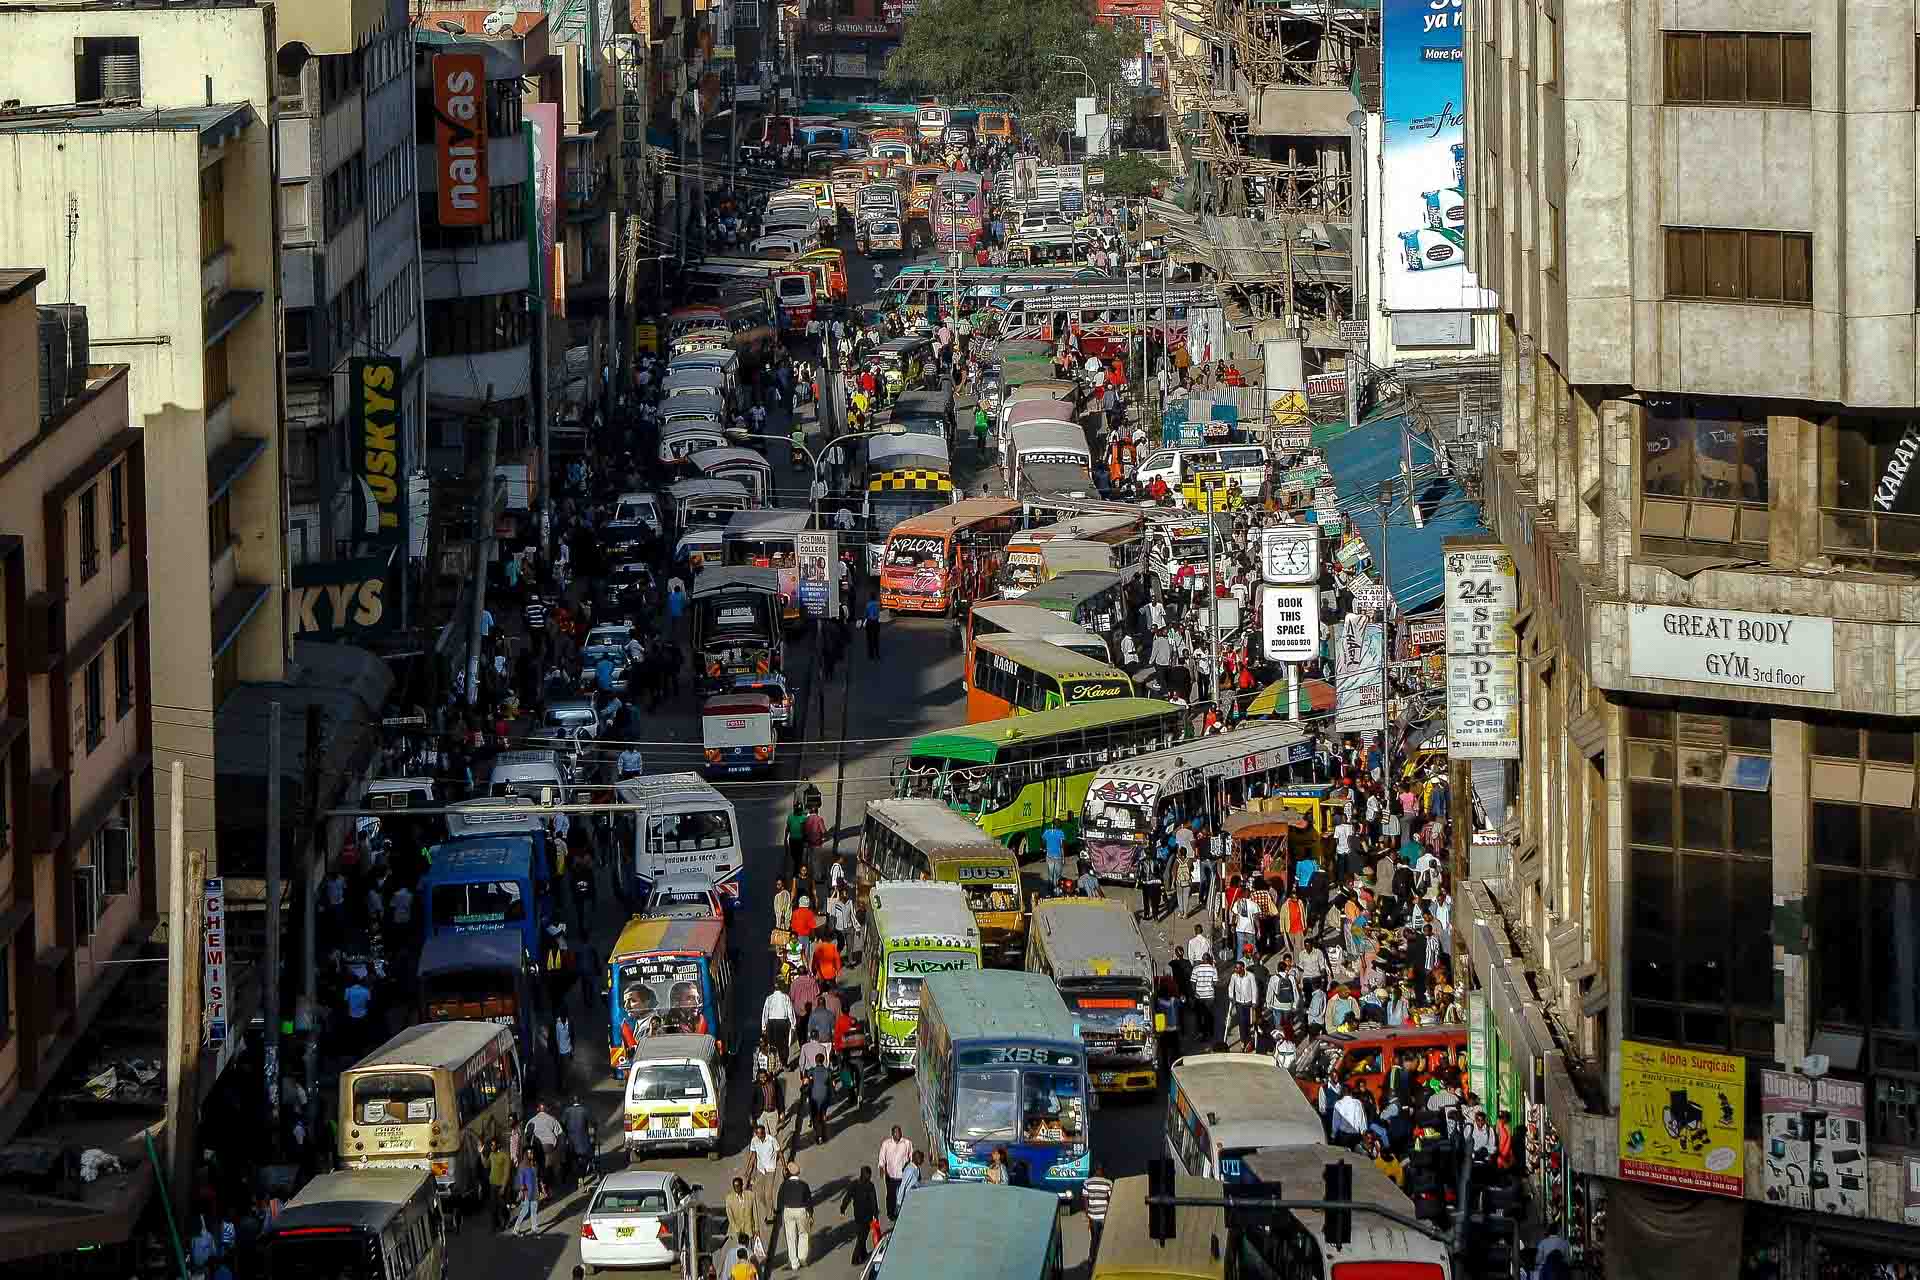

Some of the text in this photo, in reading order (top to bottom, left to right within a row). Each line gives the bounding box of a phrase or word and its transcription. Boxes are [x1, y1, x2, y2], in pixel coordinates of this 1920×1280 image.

[865, 23, 888, 33] PLAZA
[1425, 48, 1449, 59] More
[1308, 377, 1345, 395] BOOKSH
[357, 365, 399, 533] TUSKYS
[1024, 453, 1086, 465] MARTIAL
[800, 545, 827, 553] COLLEGE
[891, 538, 943, 554] XPLORA
[1458, 579, 1493, 600] 24
[290, 578, 385, 632] KYS
[1277, 597, 1303, 608] BOOK
[1279, 611, 1301, 622] THIS
[1276, 624, 1305, 635] SPACE
[1412, 629, 1446, 643] CHEMIS
[1663, 613, 1793, 645] GREAT BODY
[1299, 638, 1311, 647] 920
[1470, 606, 1494, 712] STUDIO
[1705, 652, 1806, 687] GYM 3rd floor
[207, 897, 224, 1017] CHEMIST
[624, 966, 637, 976] YOU
[642, 965, 658, 974] WEAR
[893, 958, 971, 974] shiznit
[999, 1047, 1049, 1062] KBS
[674, 1128, 695, 1138] SACCO
